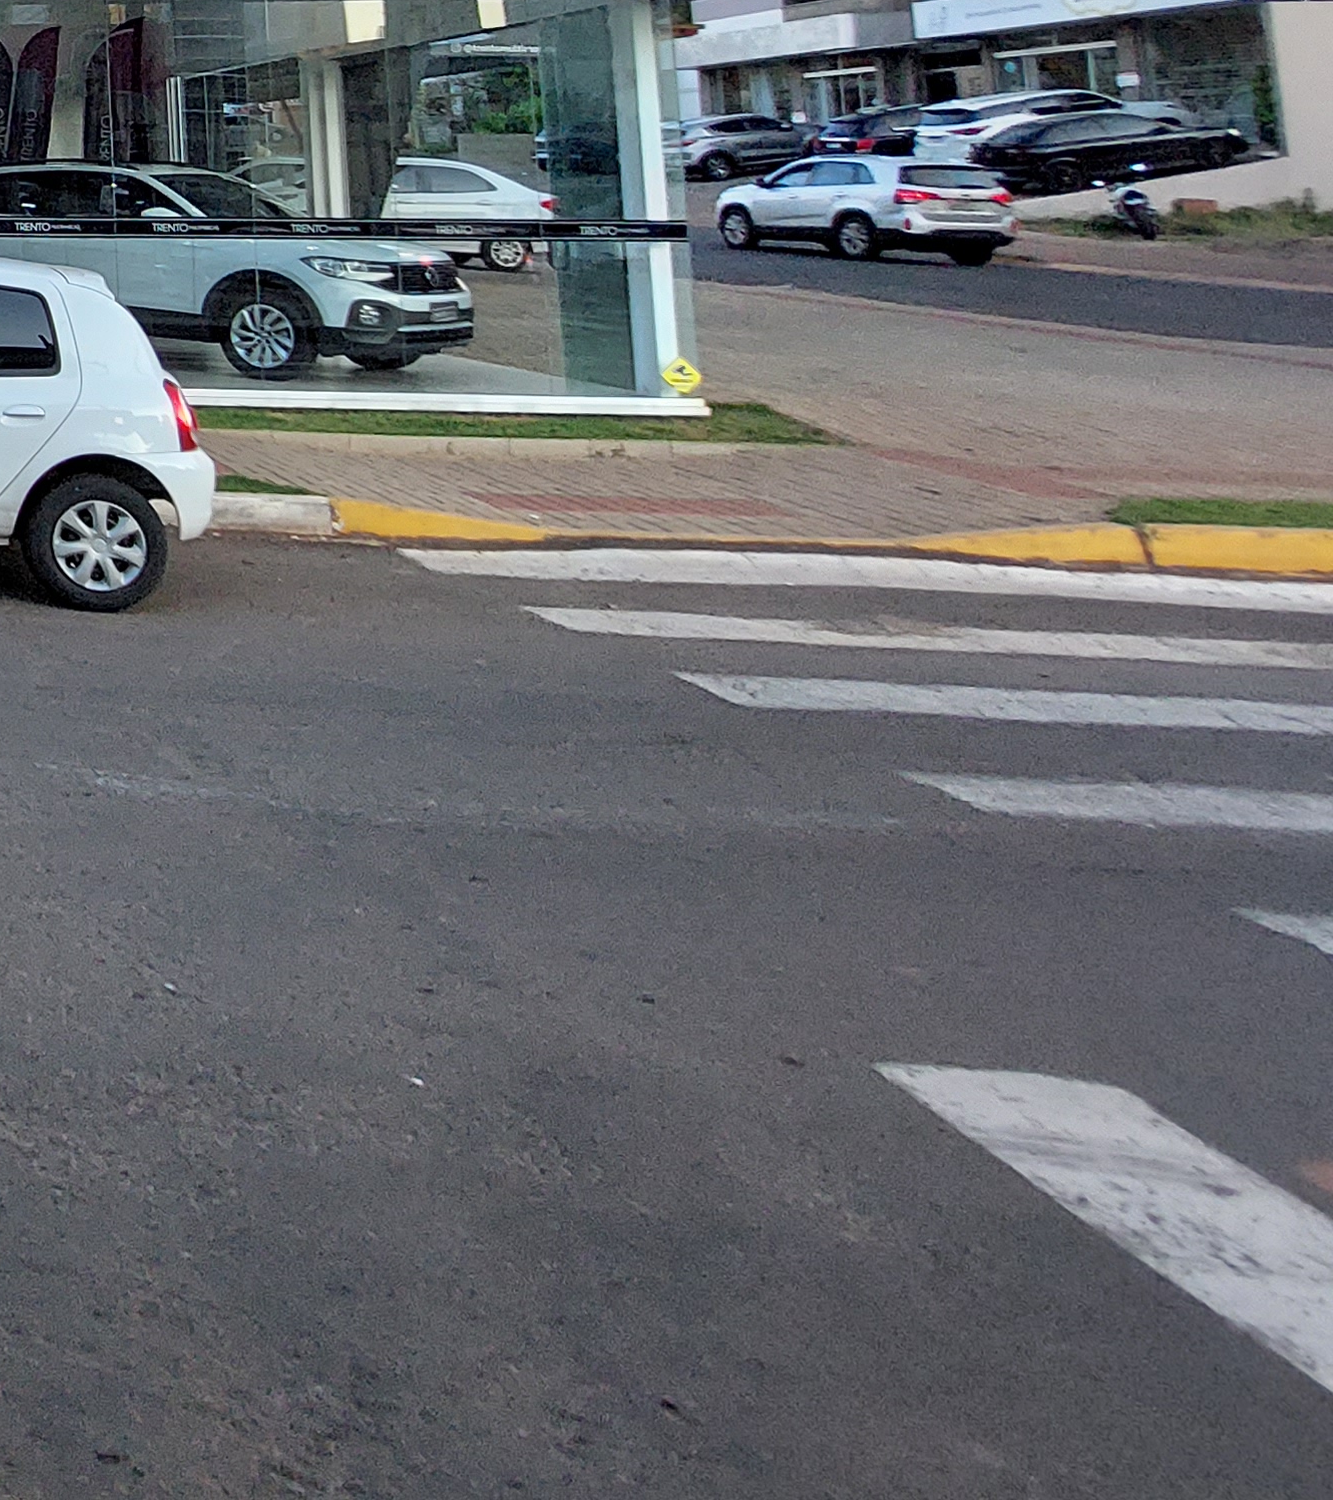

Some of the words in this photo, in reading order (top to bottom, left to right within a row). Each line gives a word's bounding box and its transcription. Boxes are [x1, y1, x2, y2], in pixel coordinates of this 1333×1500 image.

[15, 221, 51, 231] TRENTO
[152, 222, 188, 232] TRENTO
[290, 223, 329, 233] TRENTO
